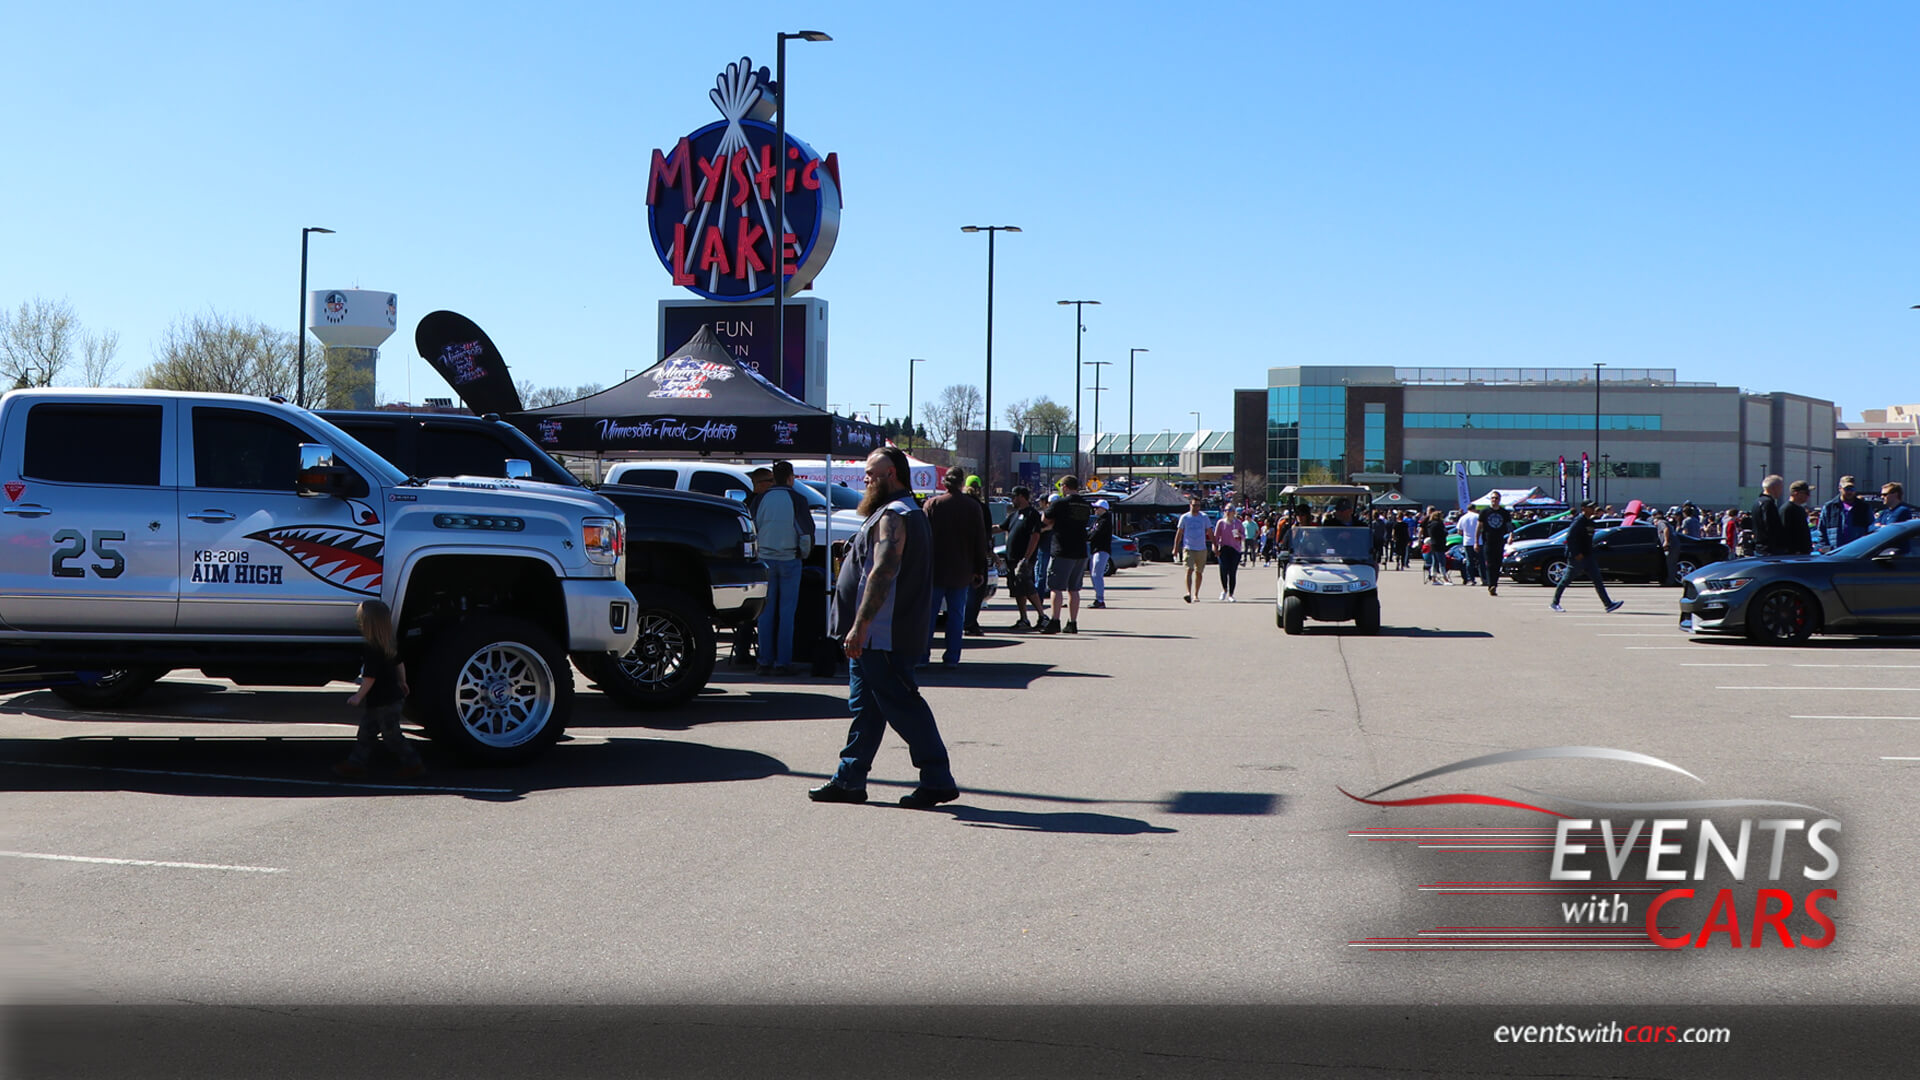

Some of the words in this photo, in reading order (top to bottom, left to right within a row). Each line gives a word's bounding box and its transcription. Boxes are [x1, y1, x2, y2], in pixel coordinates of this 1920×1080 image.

[673, 216, 799, 286] LAKE
[716, 321, 753, 337] FUN
[735, 345, 749, 356] IN
[595, 419, 652, 440] Minnesota
[653, 418, 687, 440] Truck
[687, 420, 738, 442] Addicts
[810, 474, 843, 482] OWNRS
[52, 529, 125, 579] 25
[194, 551, 249, 563] KB-2019
[191, 564, 229, 584] AIM
[234, 565, 284, 585] HIGH
